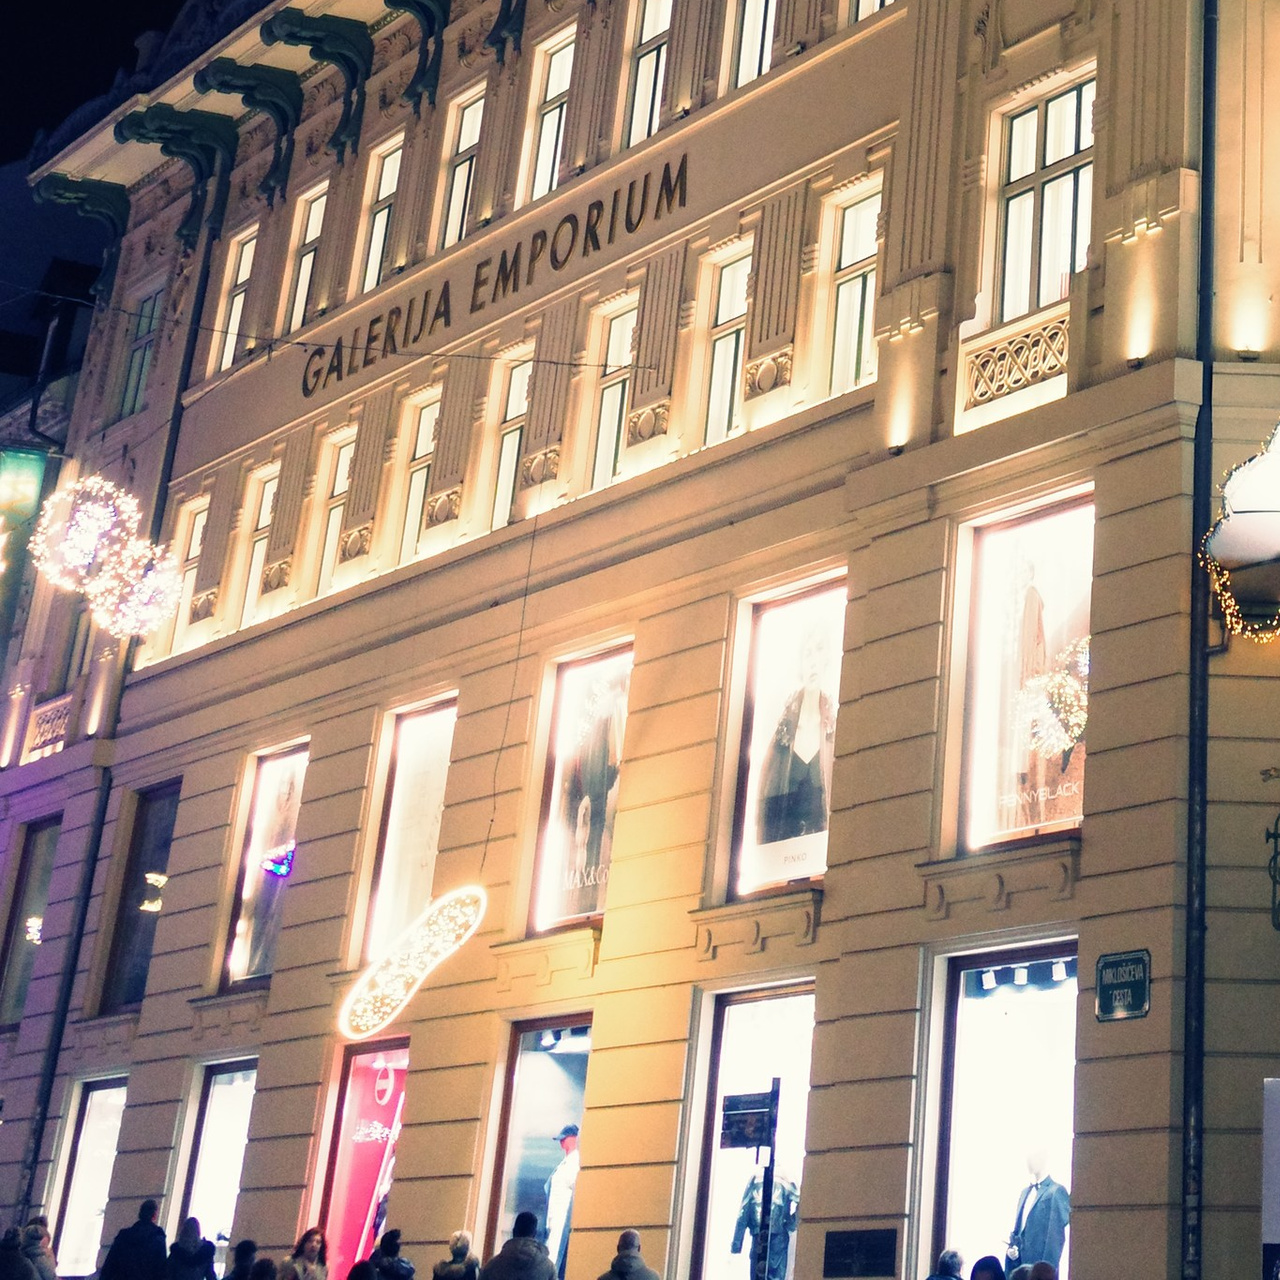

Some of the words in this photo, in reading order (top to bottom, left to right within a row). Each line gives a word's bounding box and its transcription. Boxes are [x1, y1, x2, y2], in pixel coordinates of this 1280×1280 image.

[302, 280, 451, 398] GALERIJA
[470, 153, 688, 314] EMPORIUM
[1000, 781, 1080, 807] PENNYBLACK
[1112, 988, 1133, 1007] CESTA
